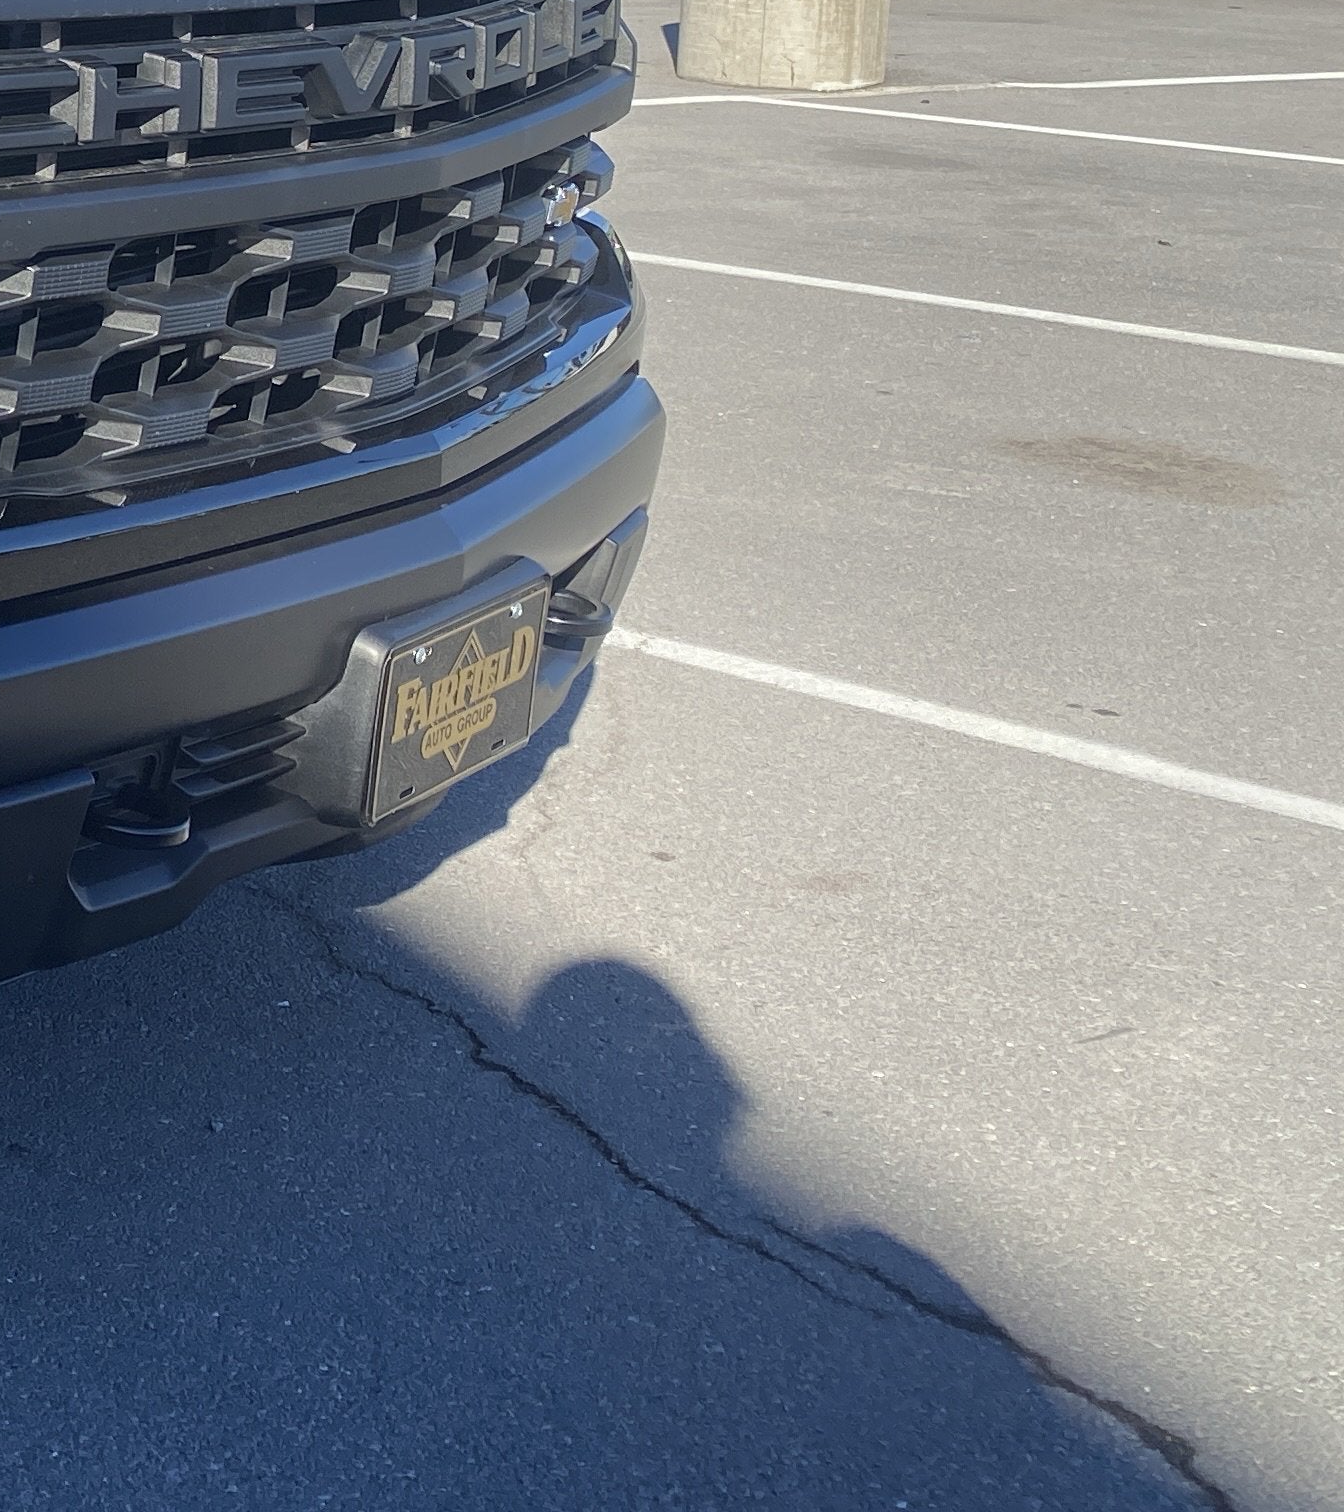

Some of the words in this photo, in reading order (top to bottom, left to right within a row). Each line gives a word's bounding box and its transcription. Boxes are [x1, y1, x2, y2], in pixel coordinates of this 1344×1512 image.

[391, 626, 536, 745] FAIRFIELD
[424, 723, 453, 751] AUTO
[456, 702, 494, 733] GROUP
